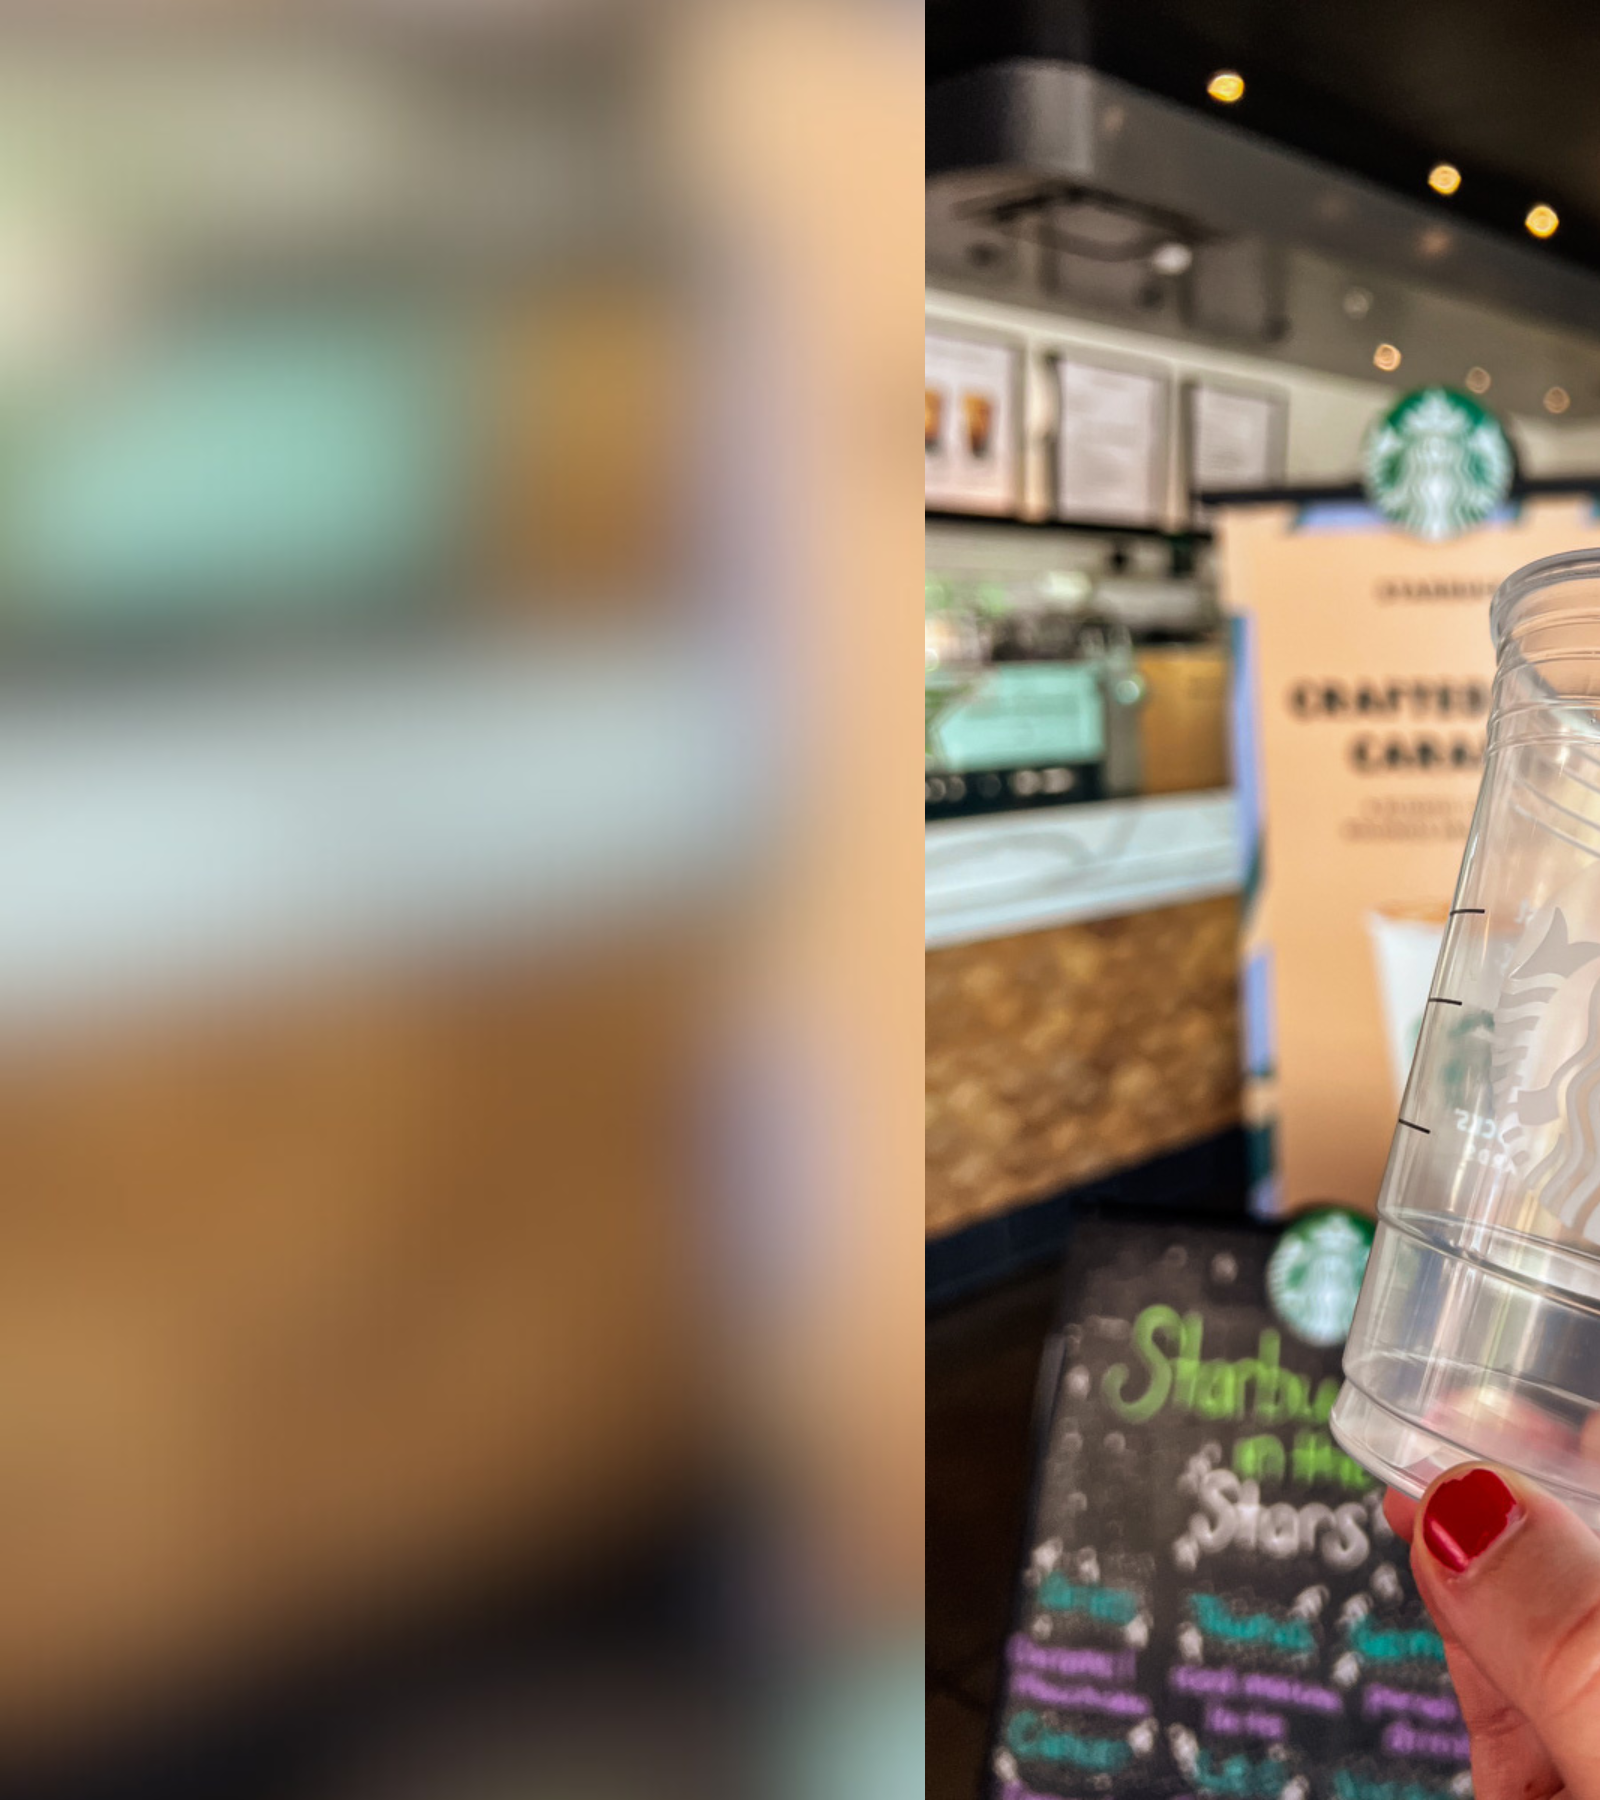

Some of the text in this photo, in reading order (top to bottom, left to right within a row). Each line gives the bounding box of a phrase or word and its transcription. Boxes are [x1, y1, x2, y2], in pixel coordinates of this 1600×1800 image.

[1350, 734, 1485, 772] CARA
[1102, 1304, 1338, 1423] Starbu
[1189, 1468, 1370, 1570] Stars
